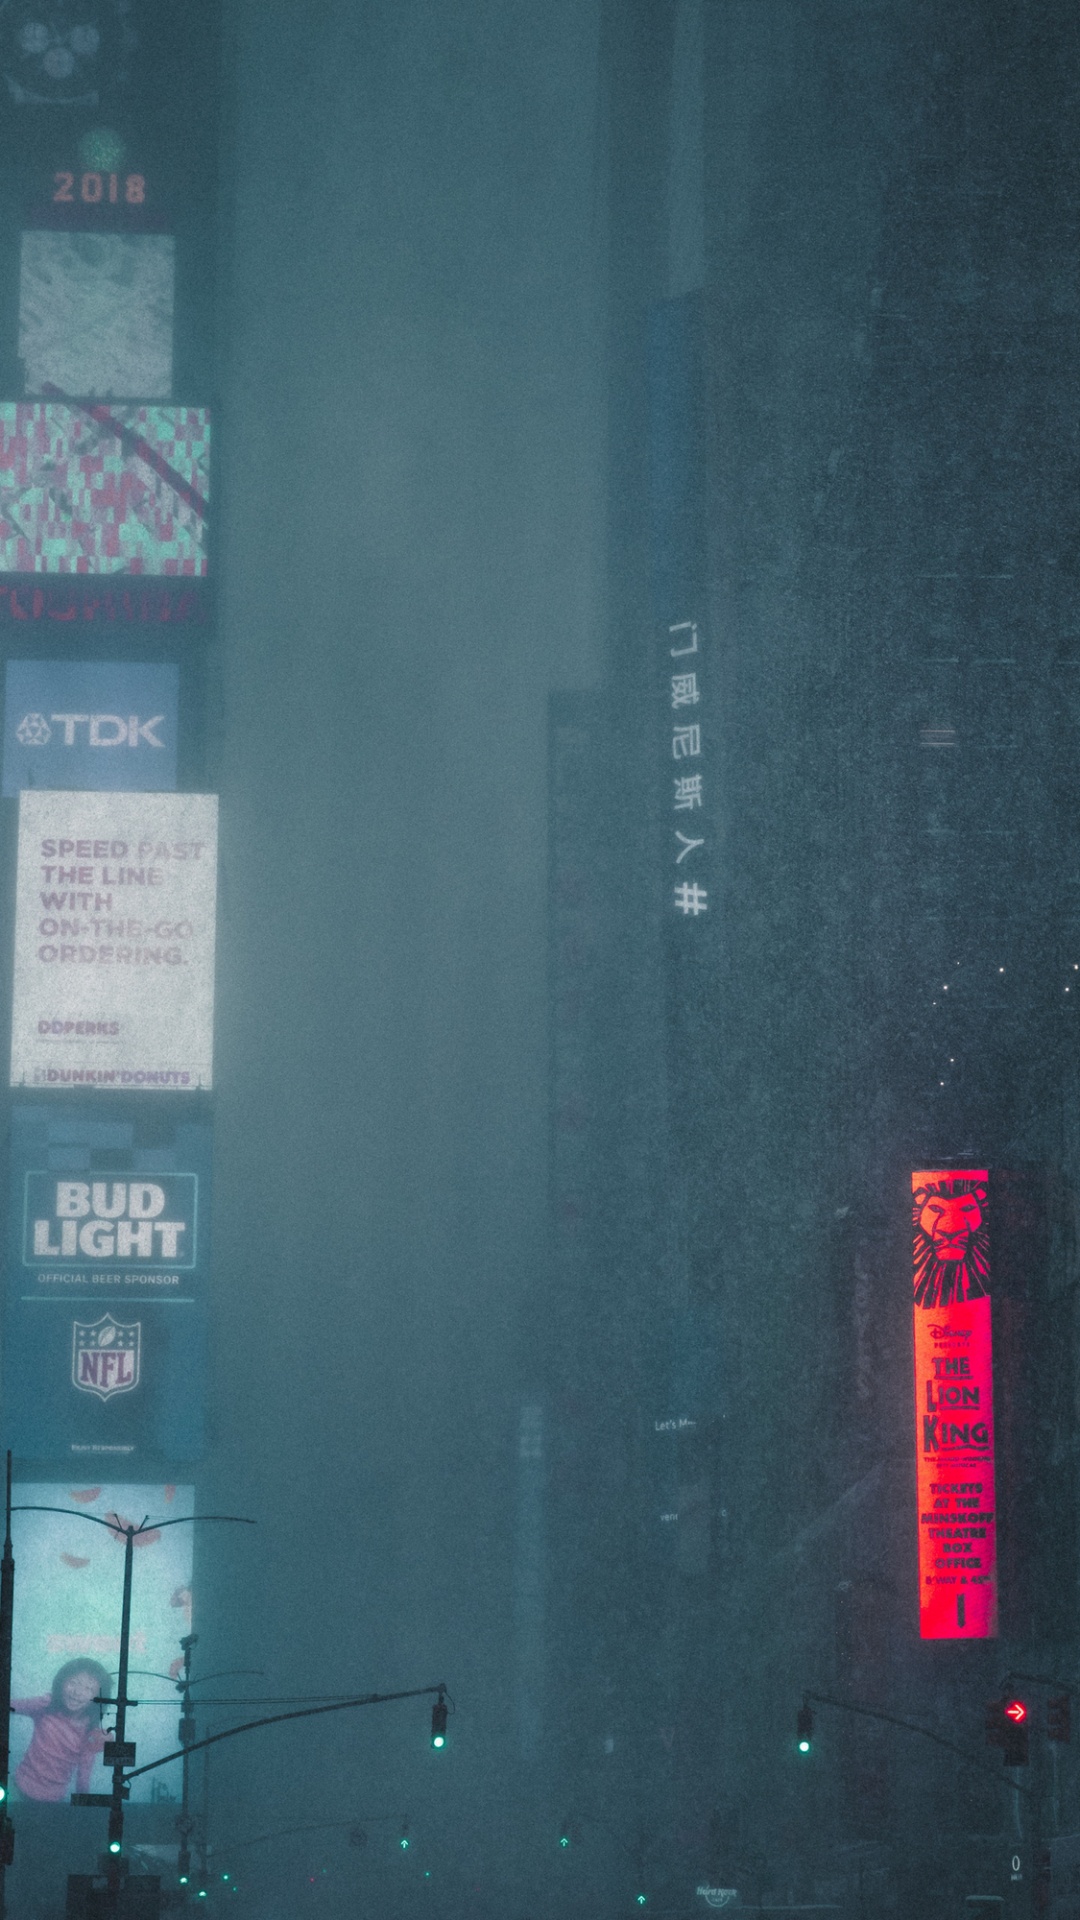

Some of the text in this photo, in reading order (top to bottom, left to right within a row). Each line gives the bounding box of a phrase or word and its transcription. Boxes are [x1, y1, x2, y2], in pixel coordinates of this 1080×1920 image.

[53, 172, 146, 204] 2018
[51, 713, 166, 747] TDK
[41, 838, 205, 861] SPEED PAST
[40, 865, 164, 886] THE LINE
[39, 891, 113, 912] WITH
[39, 917, 194, 939] ON-THE-GO
[38, 944, 190, 966] ORDERING.
[56, 1181, 165, 1219] BUD
[34, 1219, 186, 1258] LIGHT
[38, 1273, 180, 1285] OFFICIAL BEER SPONSOR
[80, 1351, 133, 1388] NFL
[931, 1357, 971, 1376] THE
[929, 1483, 983, 1494] TICKETS
[933, 1498, 980, 1508] AT THE
[921, 1513, 994, 1524] MINSKOFF
[928, 1528, 987, 1539] THEATRE
[943, 1543, 973, 1553] BOX
[935, 1558, 982, 1569] OFFICE
